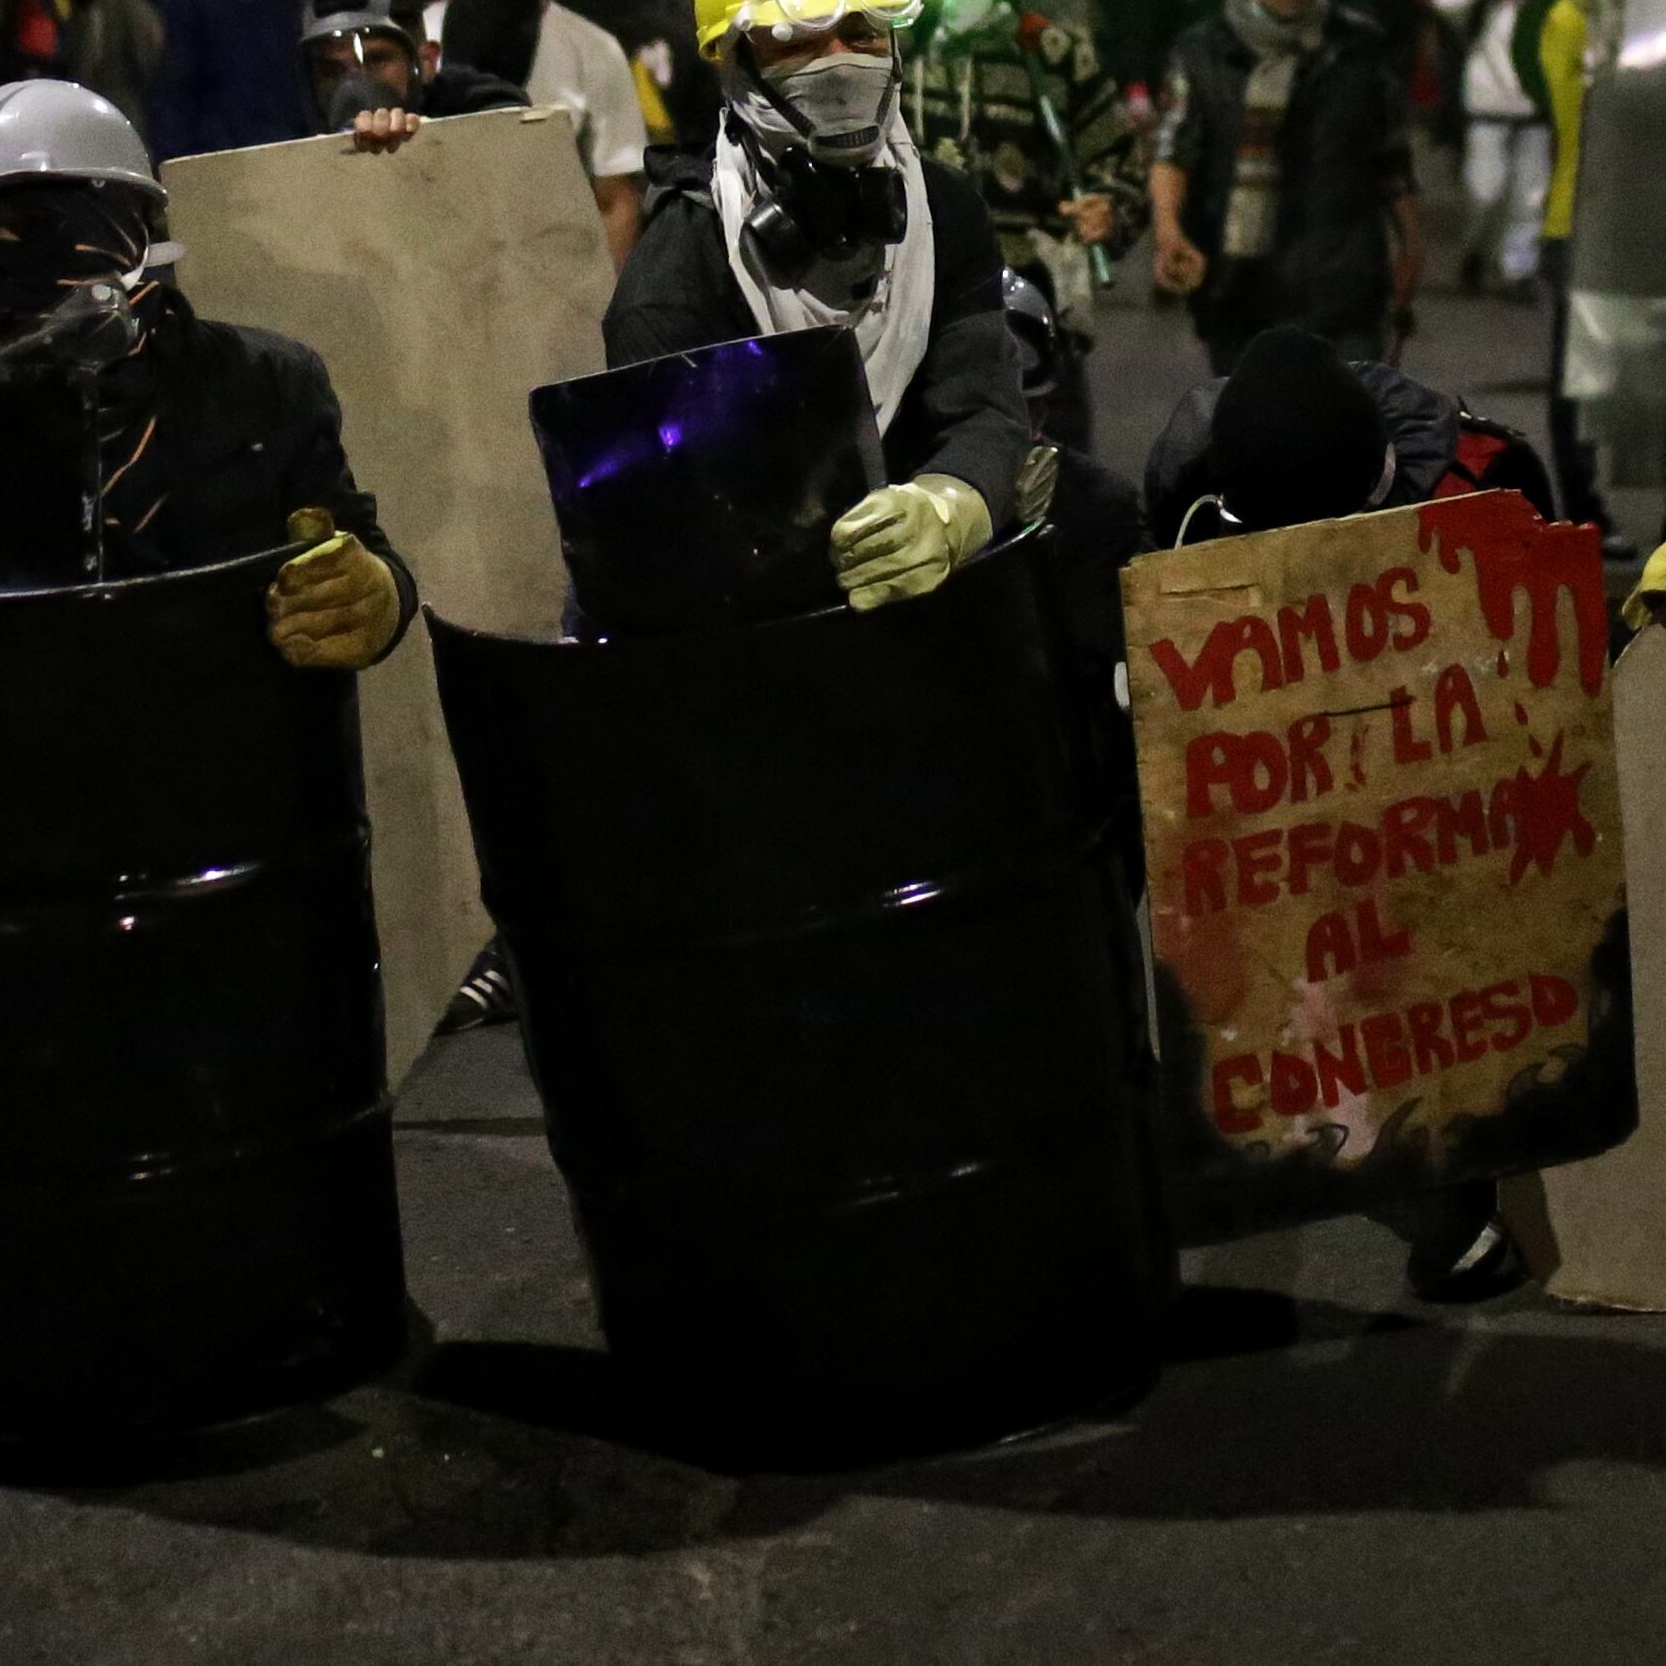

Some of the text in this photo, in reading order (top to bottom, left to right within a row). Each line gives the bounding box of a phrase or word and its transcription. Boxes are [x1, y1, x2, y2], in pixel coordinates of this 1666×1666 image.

[1149, 566, 1431, 711] VAMOS
[1185, 664, 1487, 818] POR LA
[1181, 776, 1518, 917] REFORMA
[1306, 897, 1410, 982] AL
[1212, 973, 1579, 1133] CONGRESO
